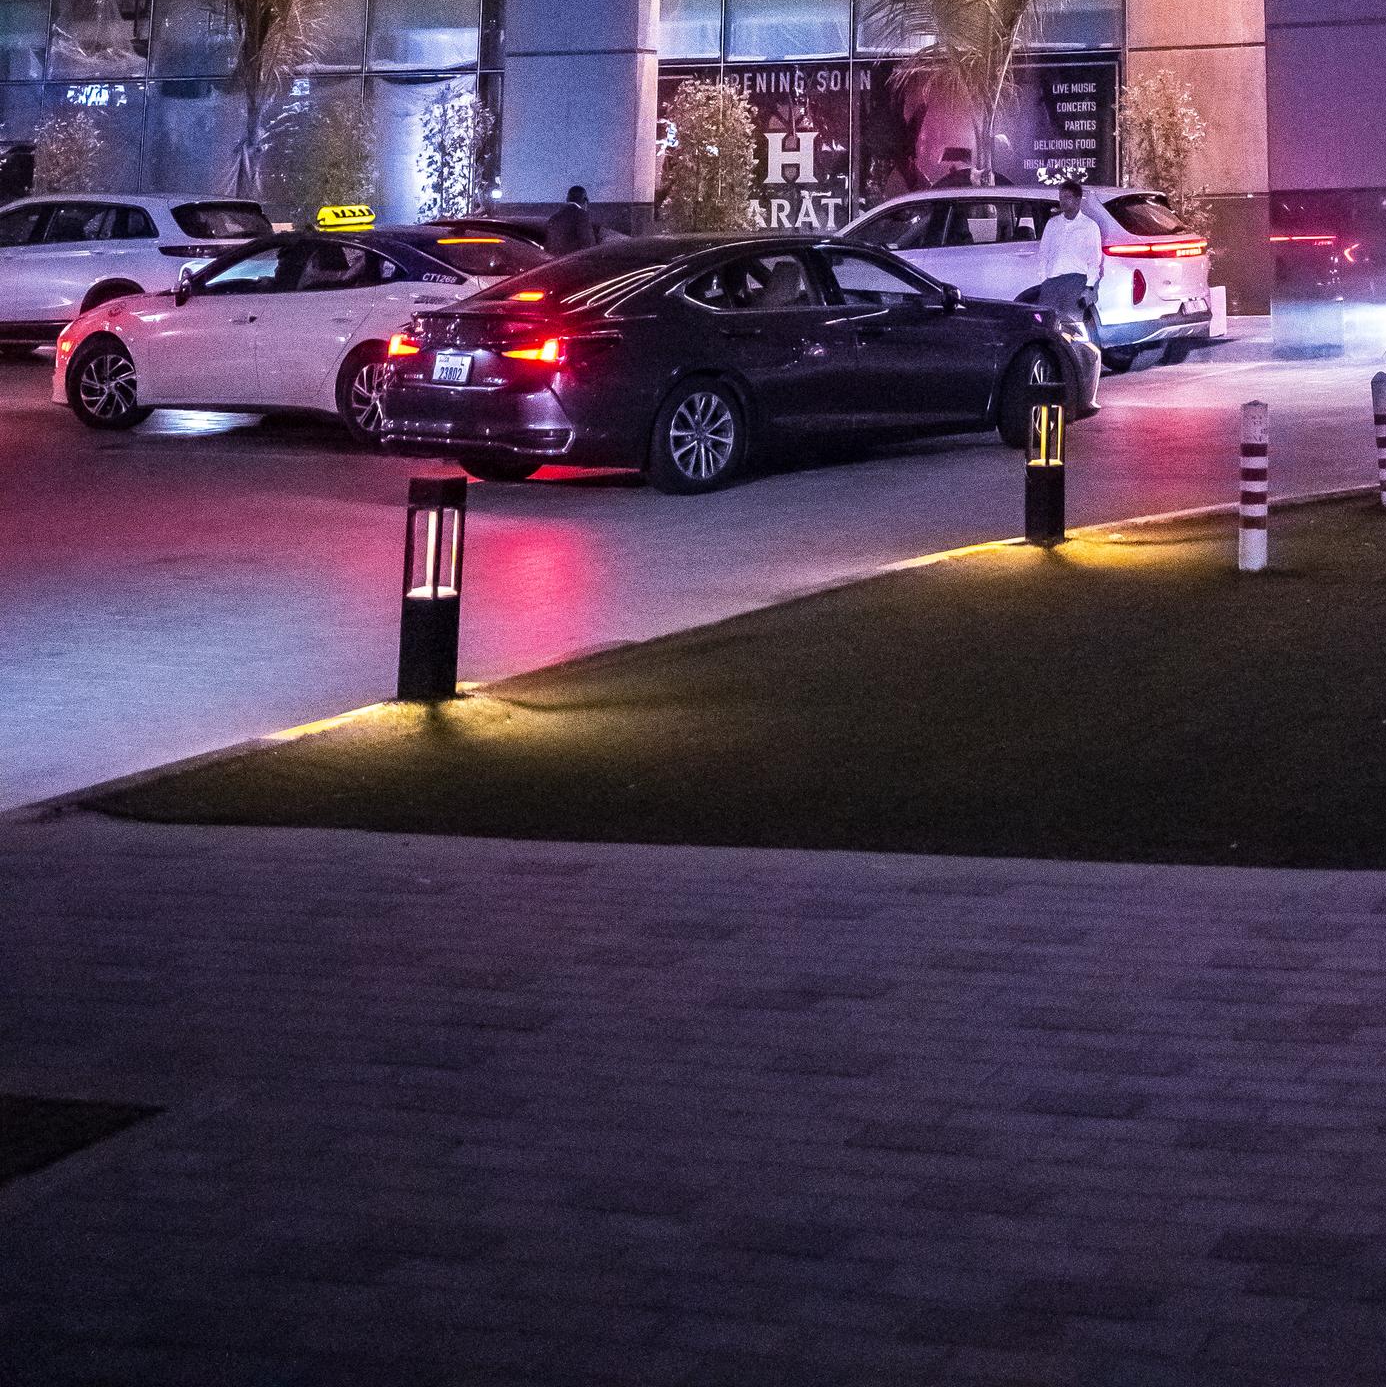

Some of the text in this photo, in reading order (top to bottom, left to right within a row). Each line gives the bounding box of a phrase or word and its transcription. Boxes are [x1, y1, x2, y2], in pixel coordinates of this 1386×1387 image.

[1052, 83, 1096, 94] LIVE MUSIC
[1056, 102, 1096, 112] CONCERTS
[1065, 120, 1096, 131] PARTIES
[1034, 139, 1096, 150] DELICIOUS FOOD
[763, 131, 820, 184] H
[1024, 158, 1096, 169] IRISH ATMOSPHERE
